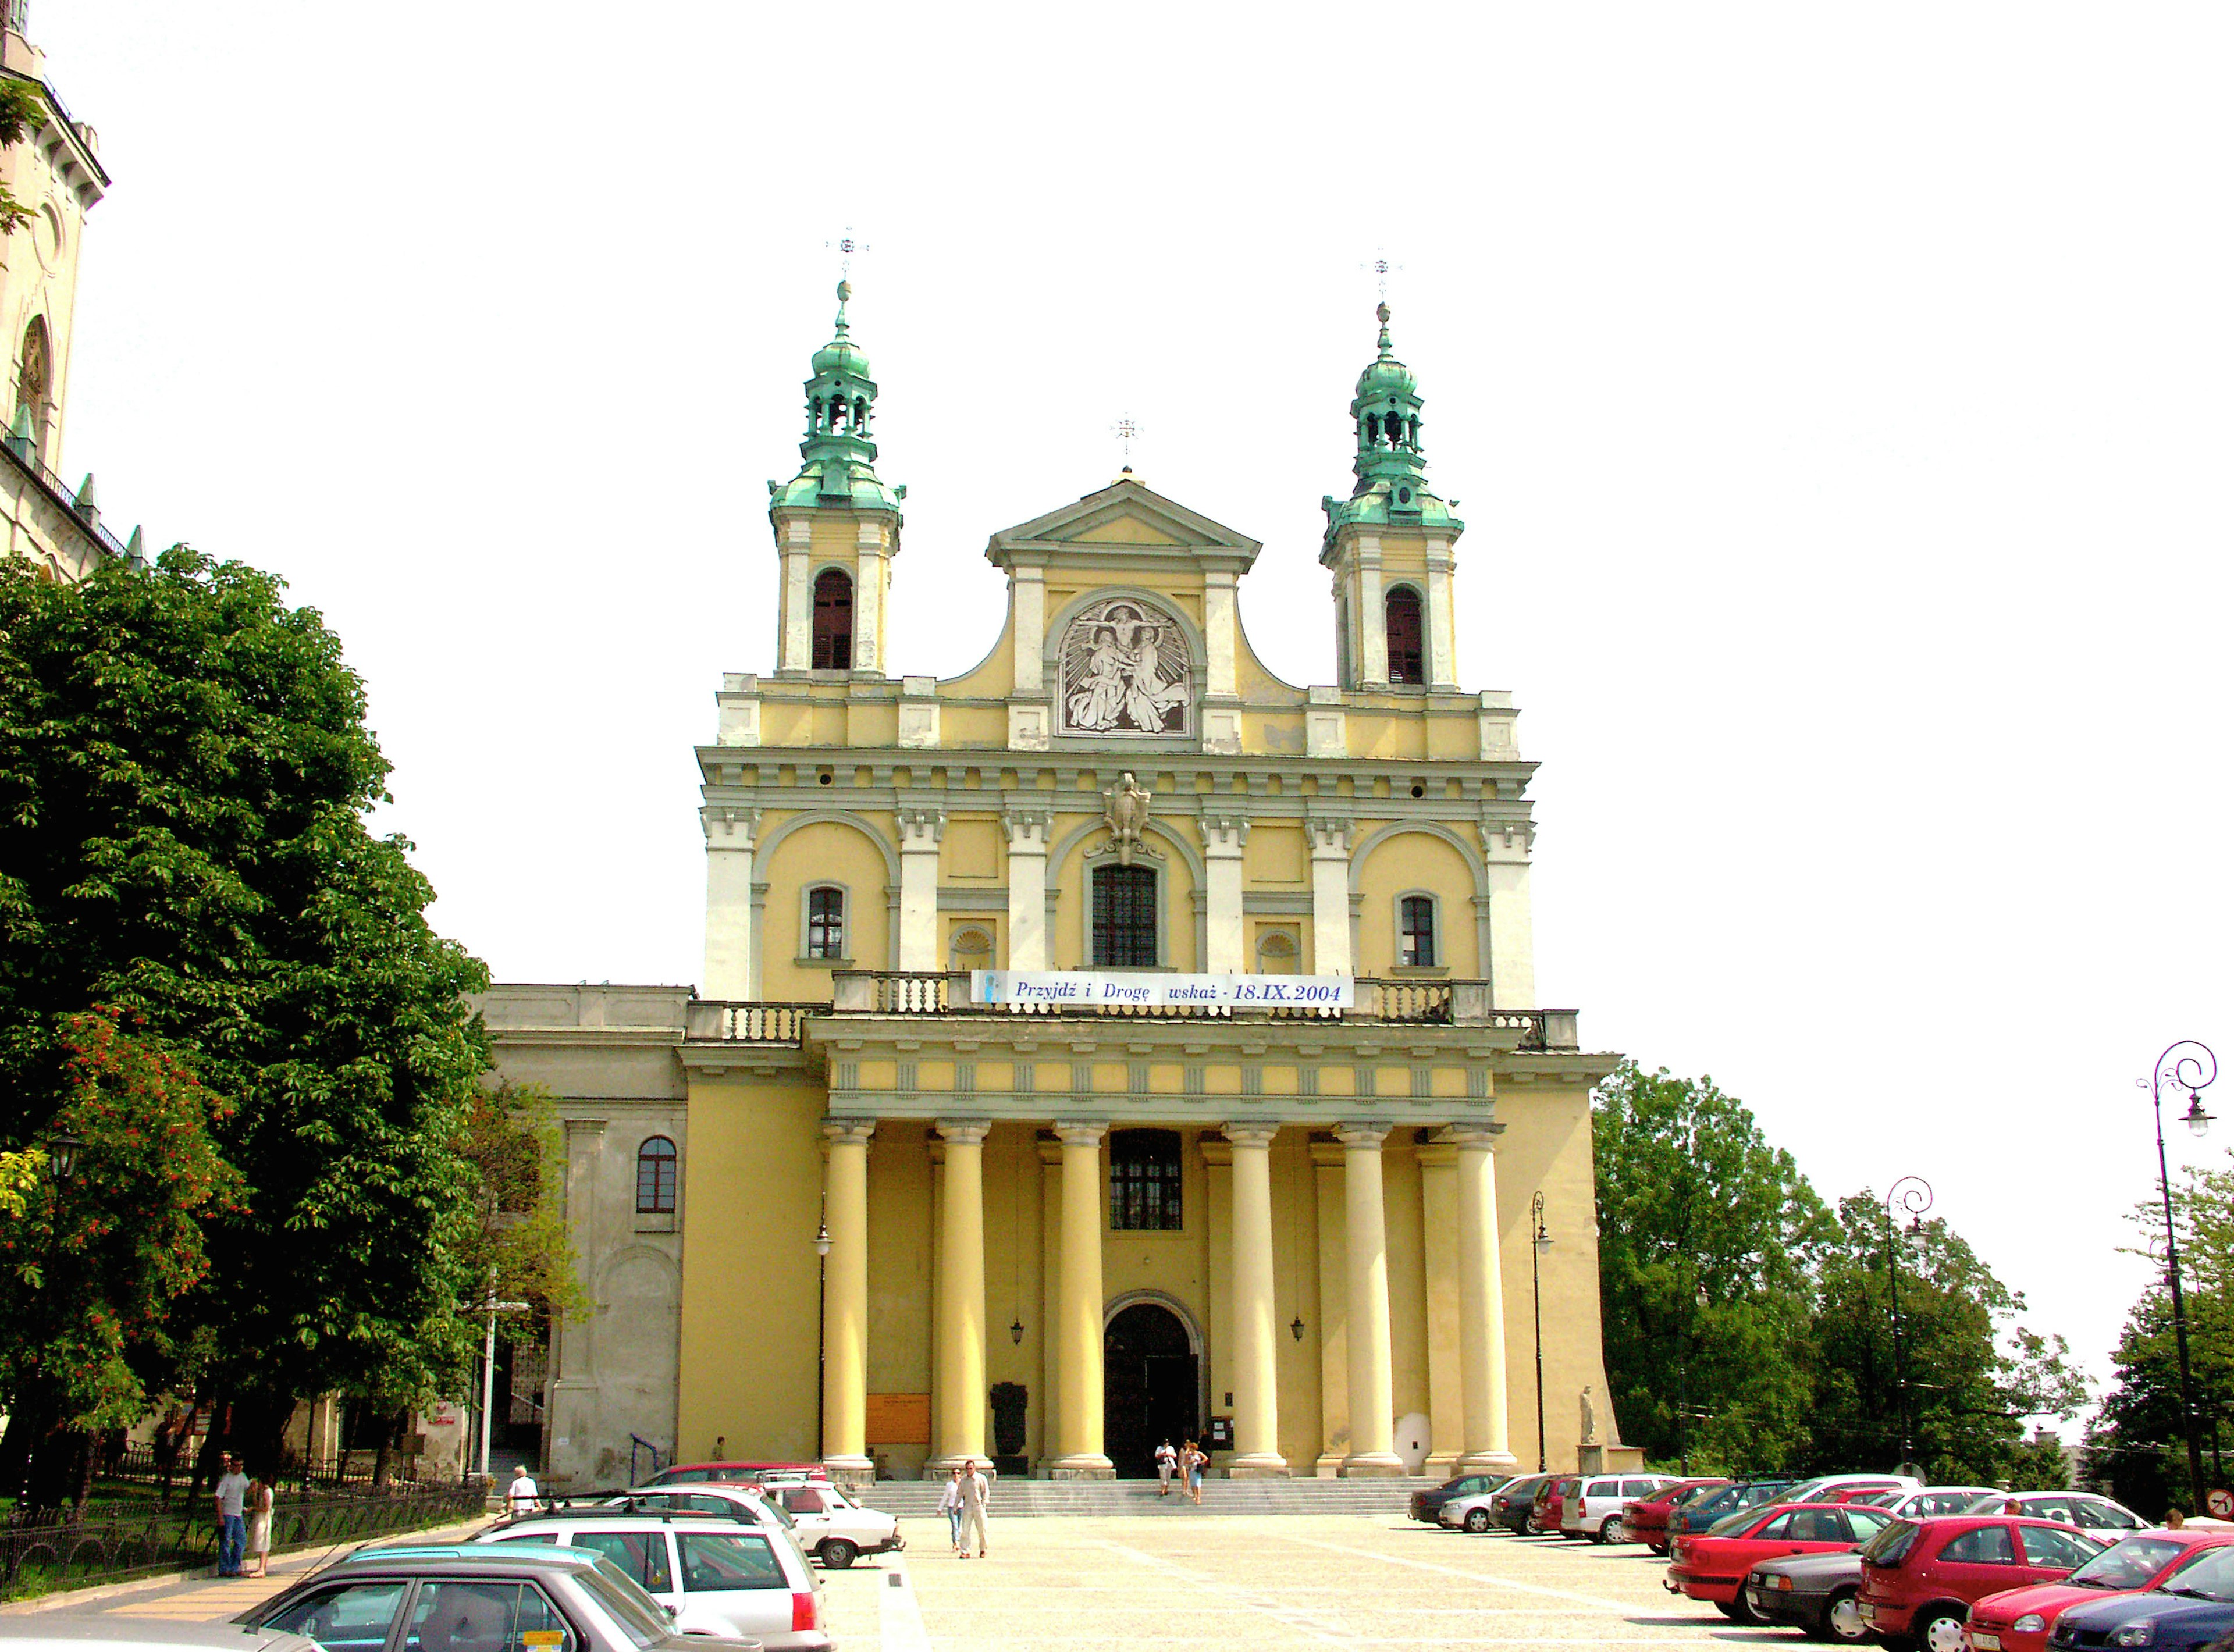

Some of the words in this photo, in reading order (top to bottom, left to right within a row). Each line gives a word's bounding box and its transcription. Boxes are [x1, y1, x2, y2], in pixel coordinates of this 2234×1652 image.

[1016, 981, 1077, 1000] Przyjdź
[1086, 981, 1091, 997] i
[1102, 983, 1150, 1001] Drogę
[1168, 984, 1217, 999] wskaż
